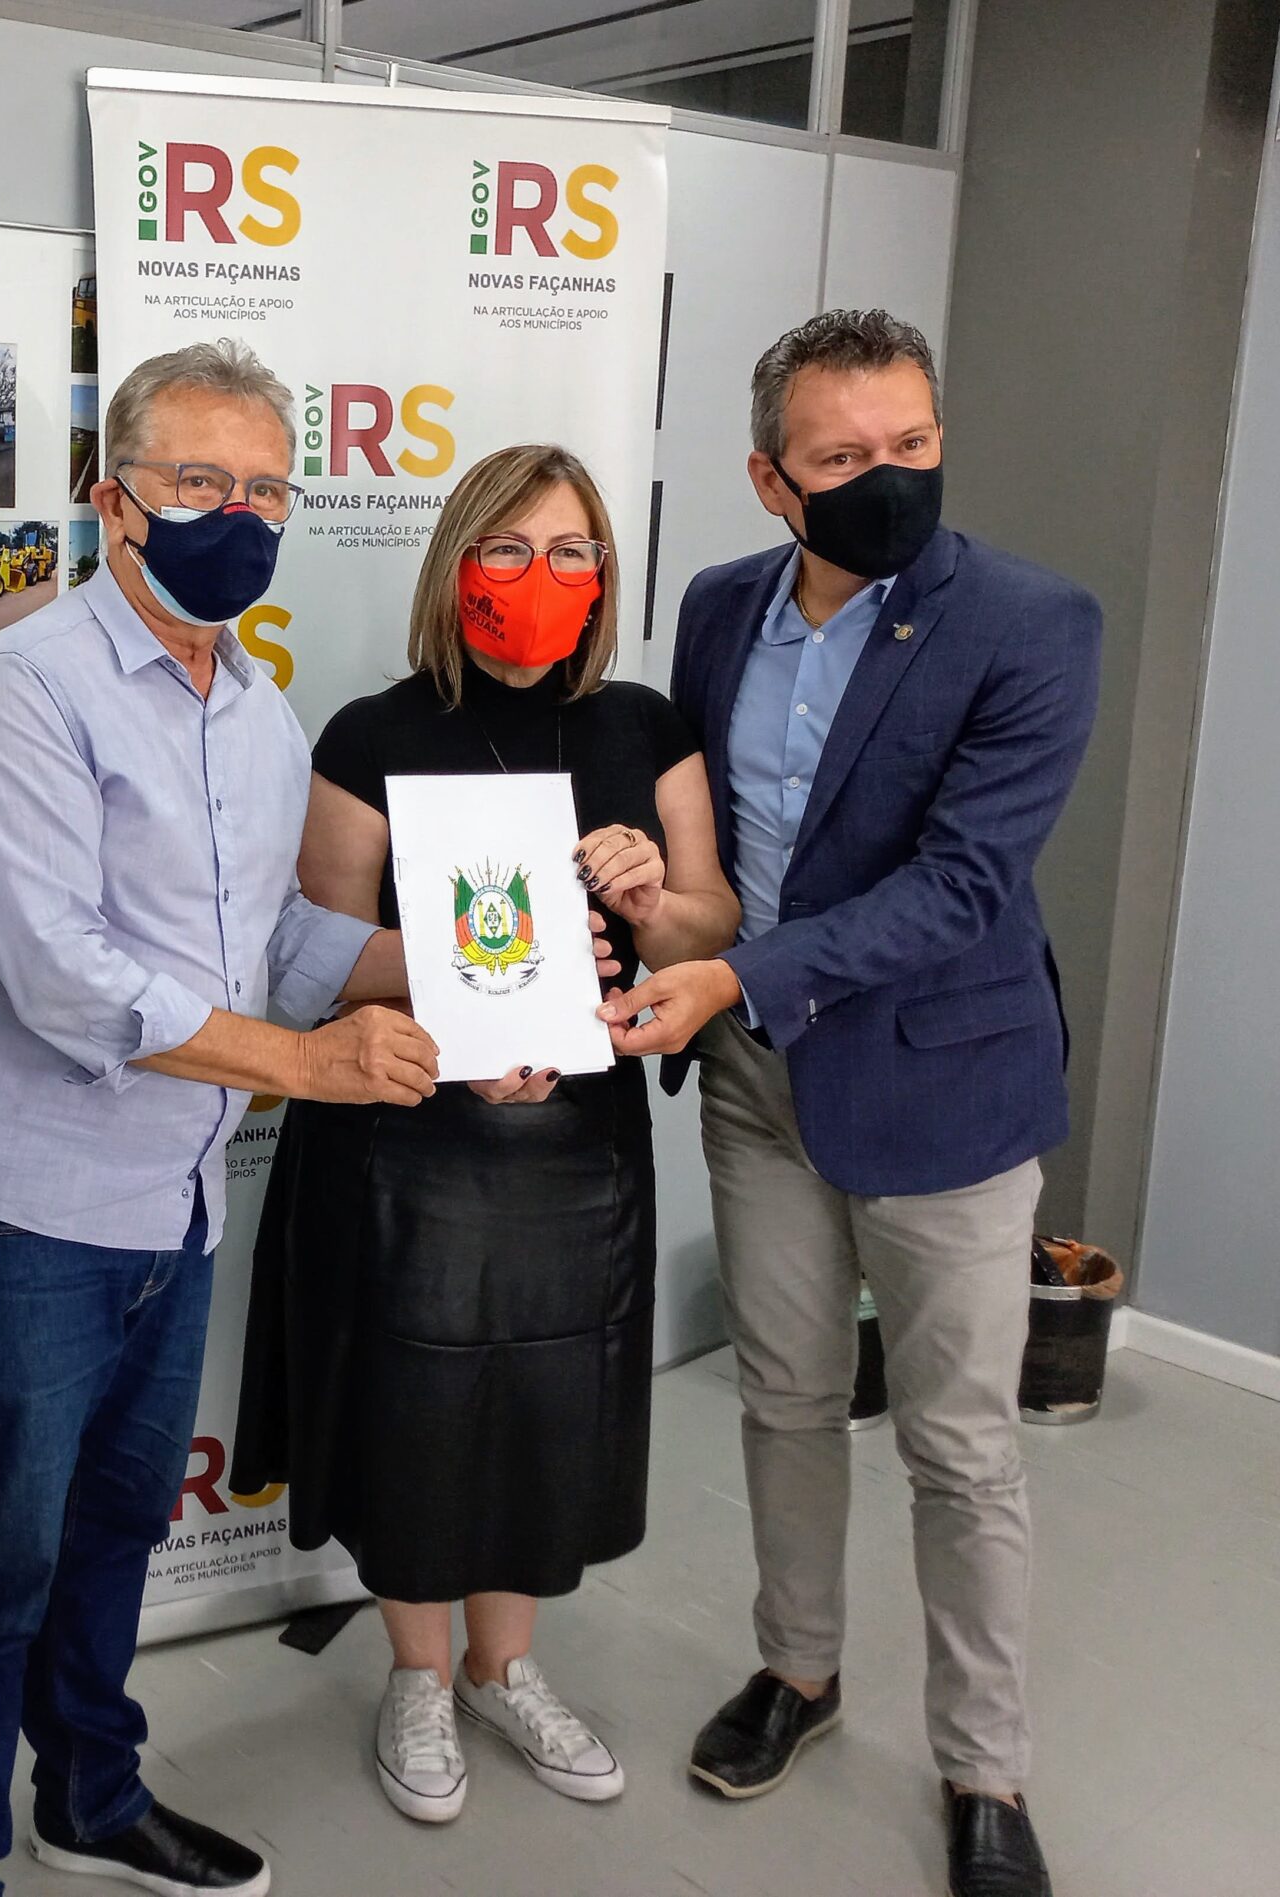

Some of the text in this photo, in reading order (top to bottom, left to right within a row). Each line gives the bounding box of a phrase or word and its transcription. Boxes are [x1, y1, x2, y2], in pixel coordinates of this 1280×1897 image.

[138, 140, 158, 213] GOV
[166, 142, 302, 247] RS
[471, 160, 490, 228] GOV
[495, 161, 620, 260] RS
[138, 260, 301, 285] NOVAS FAÇANHAS
[468, 273, 616, 296] NOVAS FAÇANHAS
[144, 295, 294, 309] NA ARTICULAÇÃO E APOIO
[473, 306, 609, 319] NA ARTICULAÇÃO E APOIO
[173, 309, 266, 321] AOS MUNICÍPIOS
[499, 319, 582, 331] AOS MUNICÍPIOS
[304, 384, 324, 450] GOV
[330, 384, 456, 478] RS
[303, 494, 361, 510] NOVAS
[308, 526, 325, 536] NA
[328, 524, 402, 537] ARTICULAÇÃO
[405, 526, 411, 535] E
[336, 536, 420, 548] AOS MUNICÍPIOS
[149, 1518, 288, 1555] OVAS FAÇANHAS
[147, 1547, 282, 1580] NA ARTICULAÇÃO E APOIO
[174, 1562, 256, 1585] AOS MUNICÍPIOS
